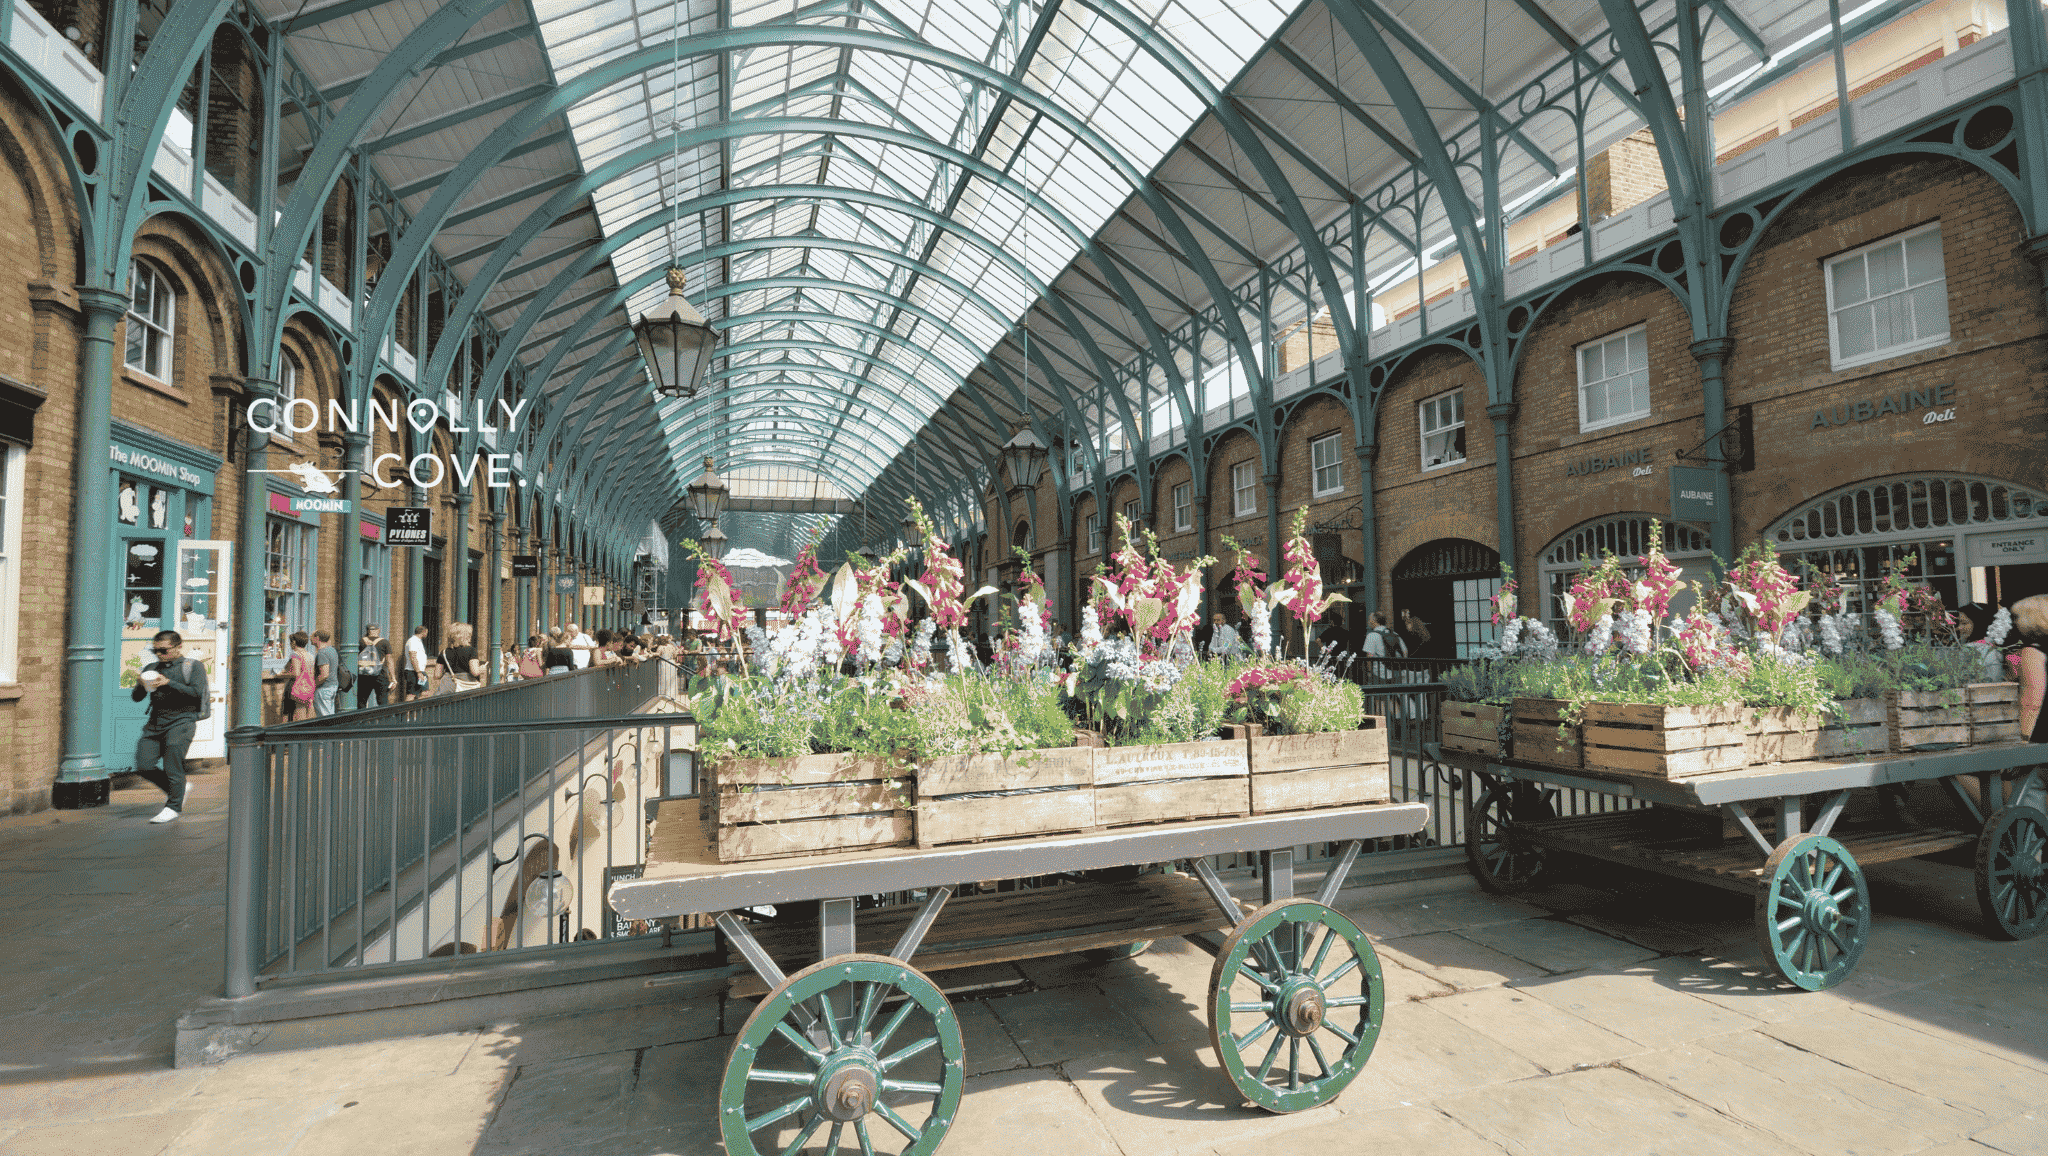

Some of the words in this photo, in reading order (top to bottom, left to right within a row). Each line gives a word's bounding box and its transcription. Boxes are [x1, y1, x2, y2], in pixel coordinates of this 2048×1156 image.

[1810, 380, 1957, 431] AUBAINE
[1923, 406, 1957, 424] Deli
[110, 445, 128, 463] The
[130, 450, 178, 477] MOOMIN
[180, 466, 201, 486] Shop
[1565, 447, 1654, 478] AUBAINE
[1633, 464, 1654, 477] Deli
[1680, 490, 1714, 500] AUBAINE
[296, 499, 343, 511] MOOMIN
[389, 529, 427, 538] PYLONES
[1992, 540, 2035, 548] ENTRANCE
